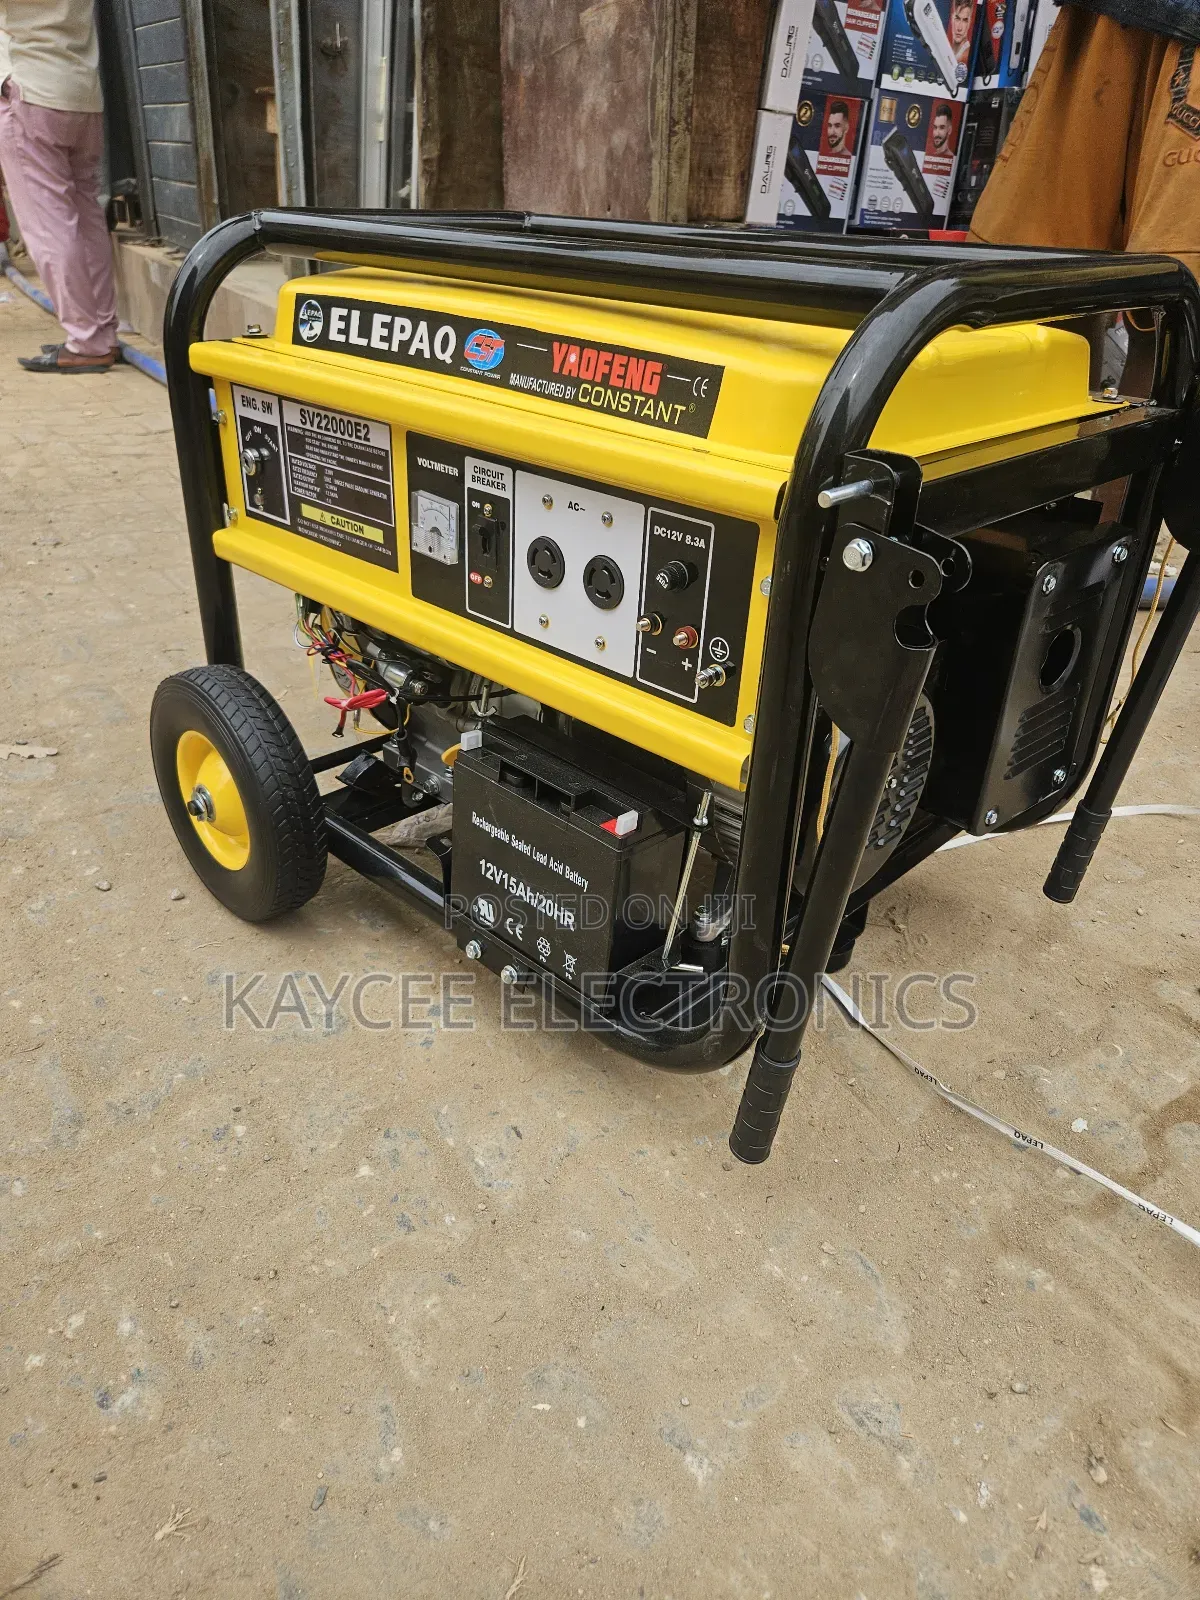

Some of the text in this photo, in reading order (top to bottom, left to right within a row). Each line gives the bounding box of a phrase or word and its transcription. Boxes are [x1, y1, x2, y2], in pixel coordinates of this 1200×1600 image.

[328, 307, 457, 365] ELEPAQ
[552, 342, 663, 395] YAOFENG
[241, 395, 272, 415] ENG. SW
[509, 372, 686, 424] MANUFACTURED BY CONSTANT
[253, 425, 262, 434] ON
[300, 408, 371, 442] SV22000E2
[264, 434, 278, 452] START
[417, 457, 458, 477] VOLTMETER
[474, 466, 504, 480] CIRCUIT
[472, 474, 506, 492] BREAKER
[330, 516, 364, 535] CAUTION
[654, 525, 705, 549] DC12V 8.3A
[470, 574, 481, 582] OFF
[656, 572, 668, 588] FUSE
[472, 811, 589, 892] Rechargeable Sealed Lead Acid Battery
[480, 859, 574, 932] 12V15Ah/20HR
[914, 1066, 938, 1085] LEPAQ
[1014, 1129, 1044, 1150] LEPAQ
